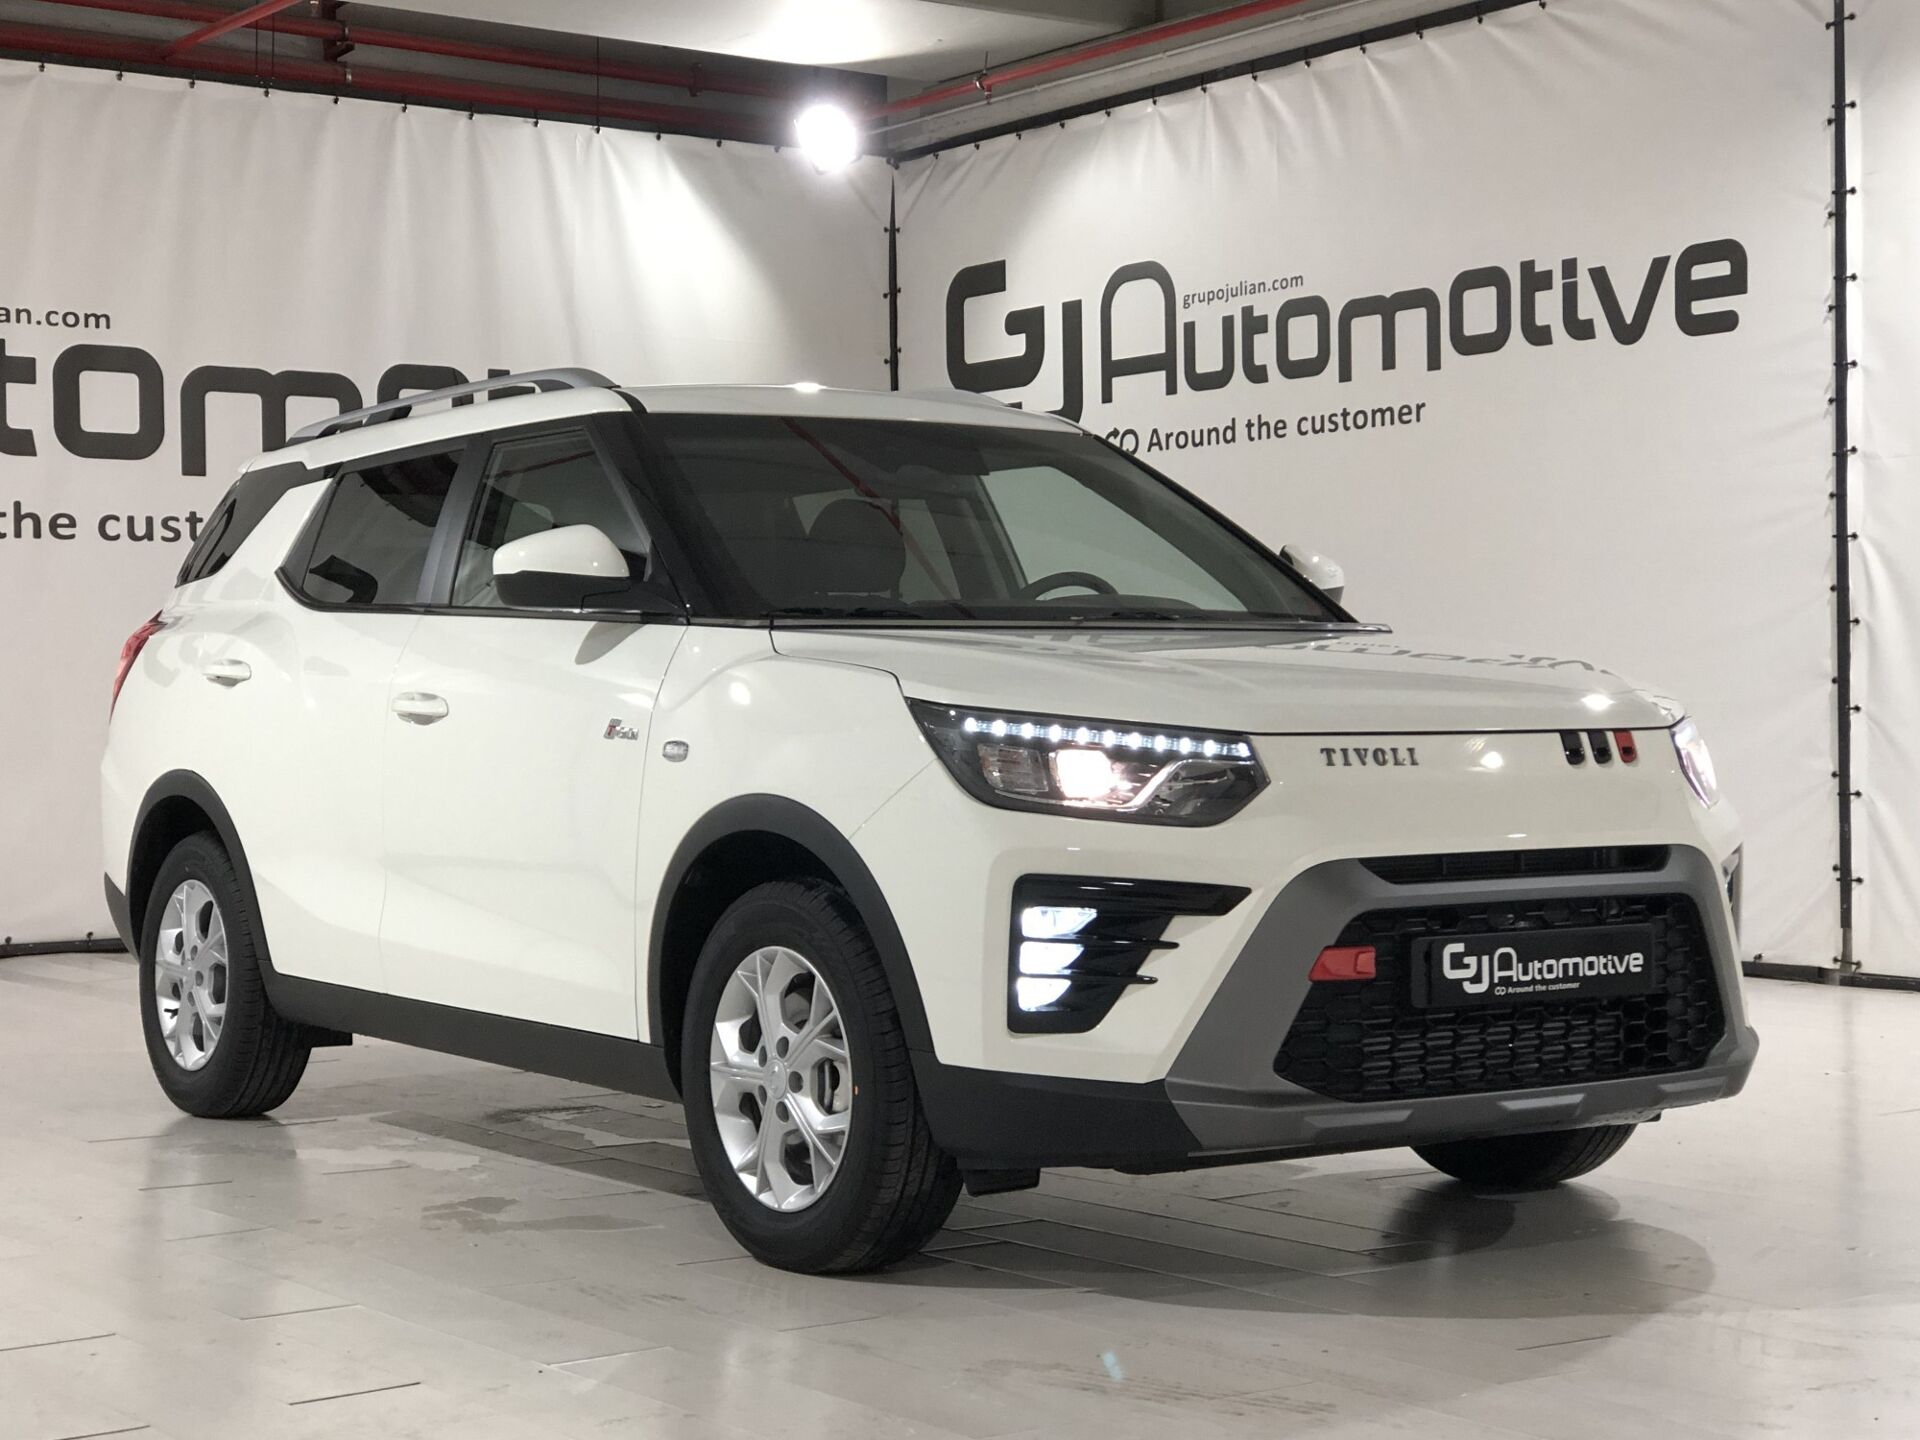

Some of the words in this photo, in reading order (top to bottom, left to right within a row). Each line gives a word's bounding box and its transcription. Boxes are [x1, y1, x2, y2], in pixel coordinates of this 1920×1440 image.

[1182, 273, 1305, 310] grupojulian.com
[1100, 238, 1748, 404] Automotive
[1146, 417, 1237, 452] Around
[1245, 414, 1288, 442] the
[1296, 402, 1426, 436] customer
[1320, 747, 1420, 767] TIVOLI
[1493, 947, 1645, 984] Automotive
[1507, 985, 1534, 994] Around
[1535, 982, 1548, 992] the
[1548, 981, 1580, 991] customer
